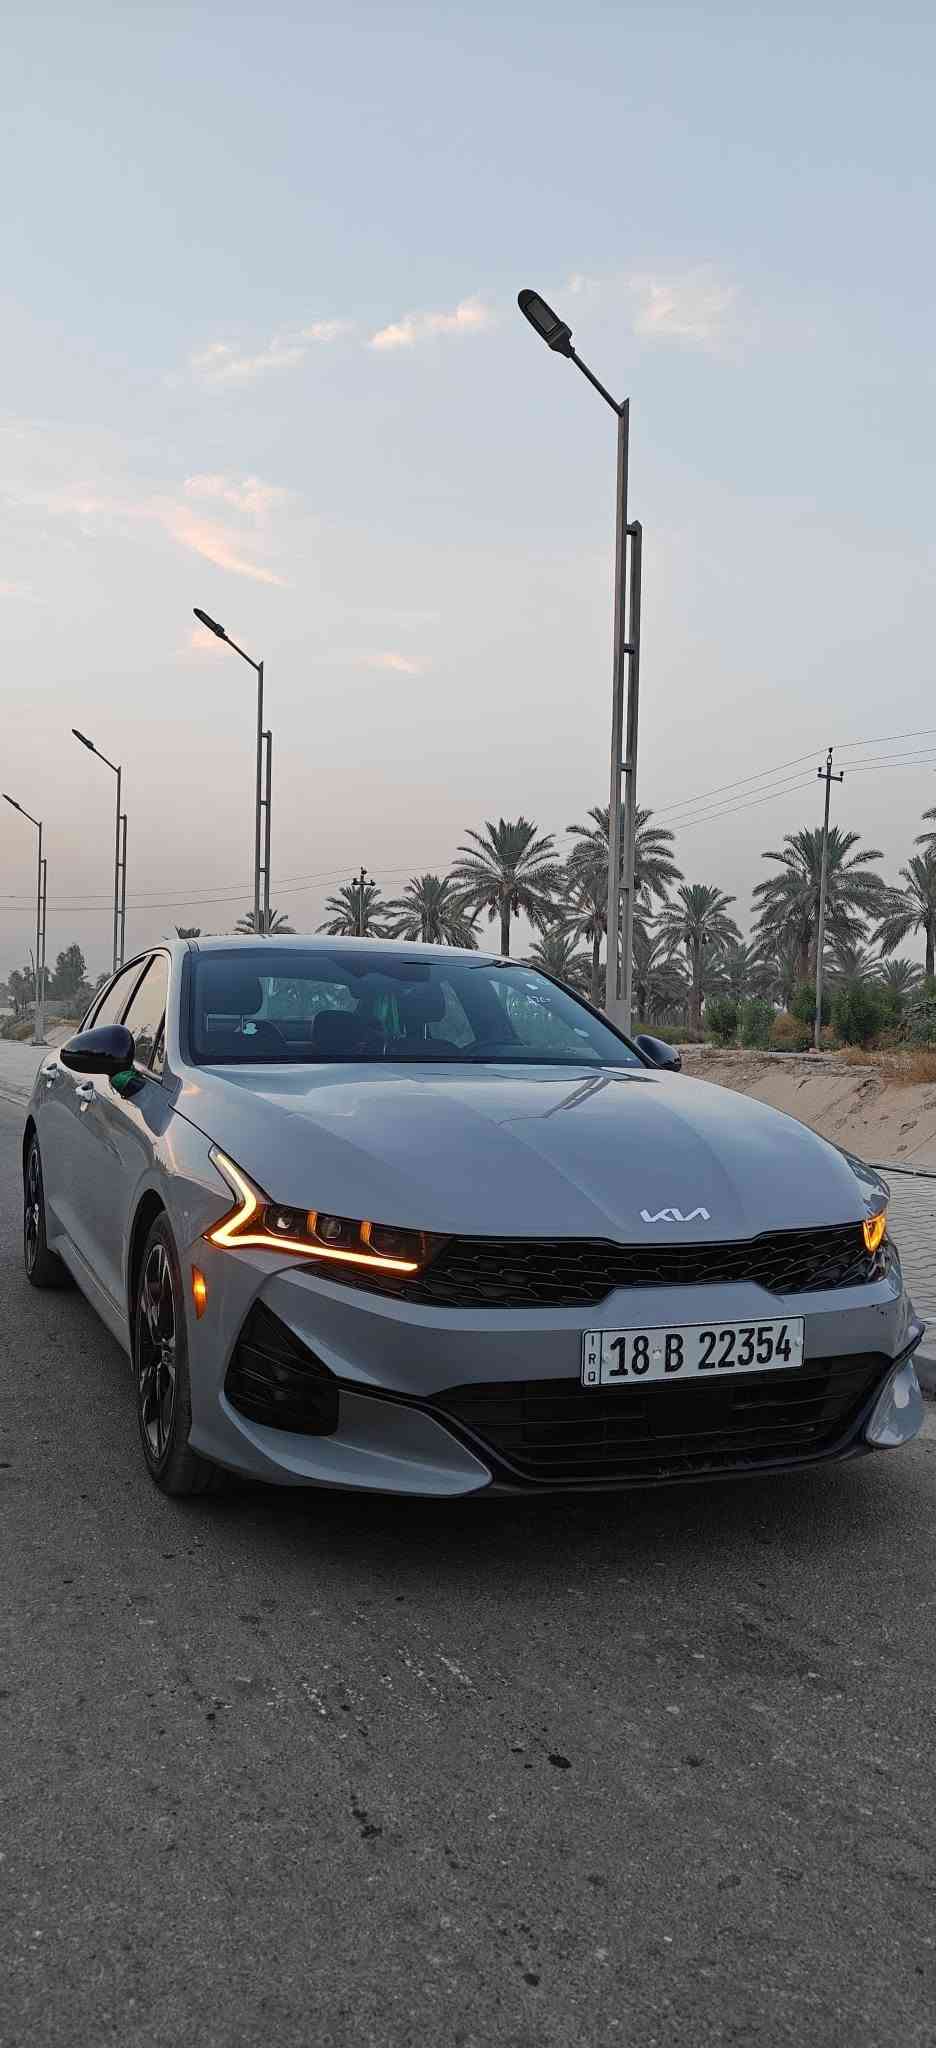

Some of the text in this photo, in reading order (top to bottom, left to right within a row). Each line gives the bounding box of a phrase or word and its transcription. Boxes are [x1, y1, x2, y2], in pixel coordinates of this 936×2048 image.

[609, 1325, 792, 1376] 18 B 22354
